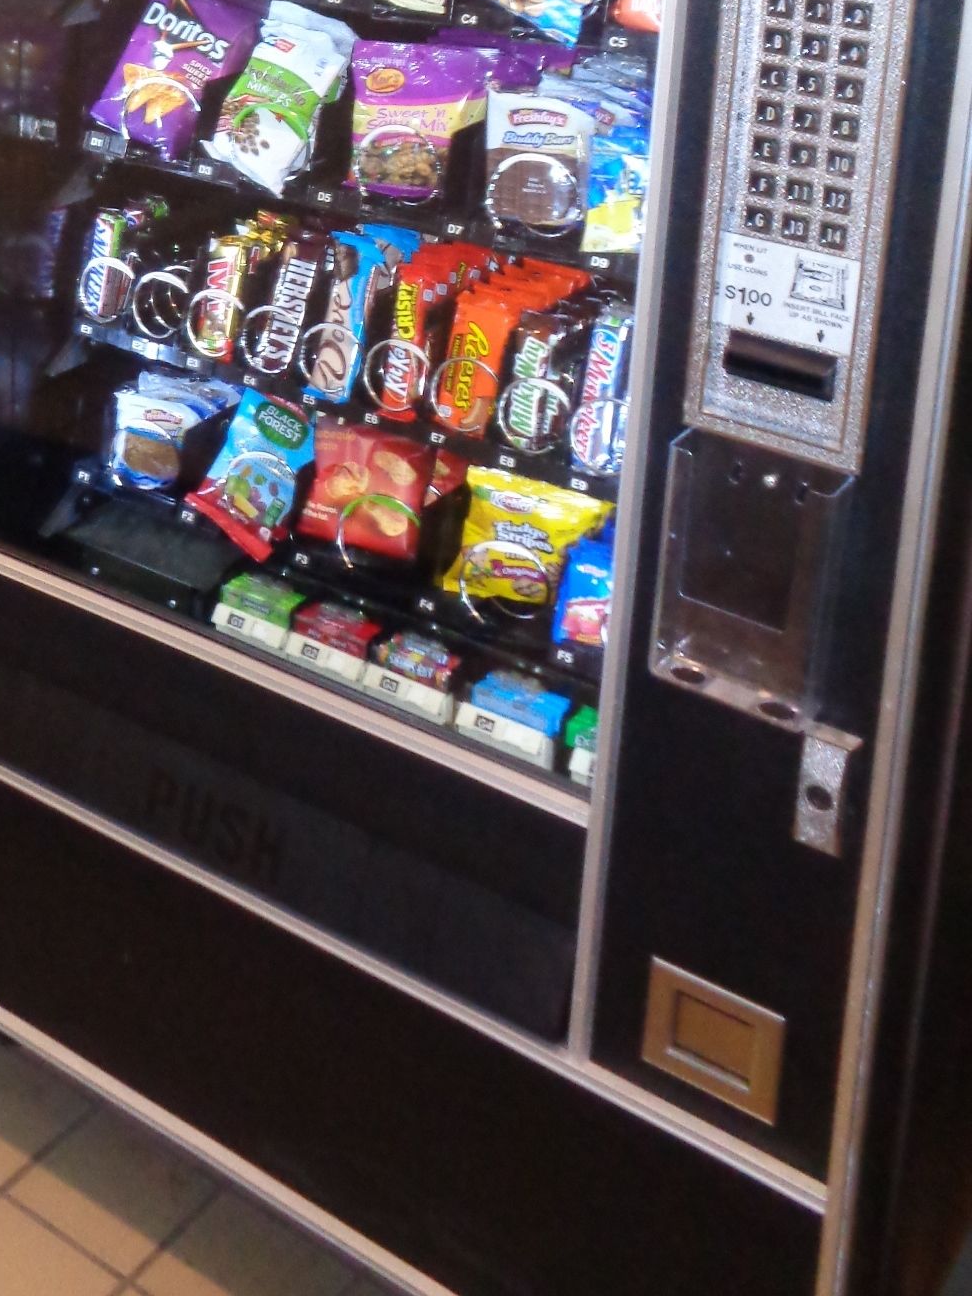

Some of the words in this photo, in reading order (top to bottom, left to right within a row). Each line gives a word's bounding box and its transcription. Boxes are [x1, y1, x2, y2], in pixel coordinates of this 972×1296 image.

[461, 14, 477, 25] C4
[143, 1, 231, 60] Doritos
[609, 37, 628, 48] C5
[377, 108, 429, 119] Sweet
[512, 110, 566, 127] Freshley's
[419, 119, 448, 132] Mix
[503, 131, 544, 149] Buddy
[544, 133, 575, 146] Bars
[198, 164, 212, 176] D3
[834, 156, 849, 172] 10
[317, 192, 333, 203] D5
[792, 184, 808, 201] 11
[829, 192, 846, 209] 12
[447, 223, 464, 235] D7
[789, 220, 805, 236] 13
[826, 227, 841, 244] 14
[756, 246, 768, 254] LIT
[590, 255, 610, 269] D9
[728, 263, 742, 272] USE
[745, 266, 768, 277] COINS
[397, 280, 416, 340] CRISPY
[812, 307, 827, 317] BILL
[830, 312, 850, 322] FACE
[788, 310, 799, 318] UP
[802, 314, 813, 322] AS
[814, 317, 844, 329] SHOWN
[319, 290, 352, 389] Dove
[596, 331, 619, 354] 3
[514, 336, 550, 379] Way
[243, 375, 256, 386] E4
[302, 395, 316, 406] E5
[509, 381, 541, 437] Milky
[265, 404, 304, 432] BLACK
[364, 412, 379, 425] E6
[258, 411, 303, 443] FOREST
[430, 431, 446, 444] E7
[499, 455, 516, 468] E8
[78, 471, 91, 482] F1
[571, 479, 589, 492] E9
[181, 510, 194, 522] F2
[295, 553, 309, 565] F3
[557, 649, 573, 664] F5
